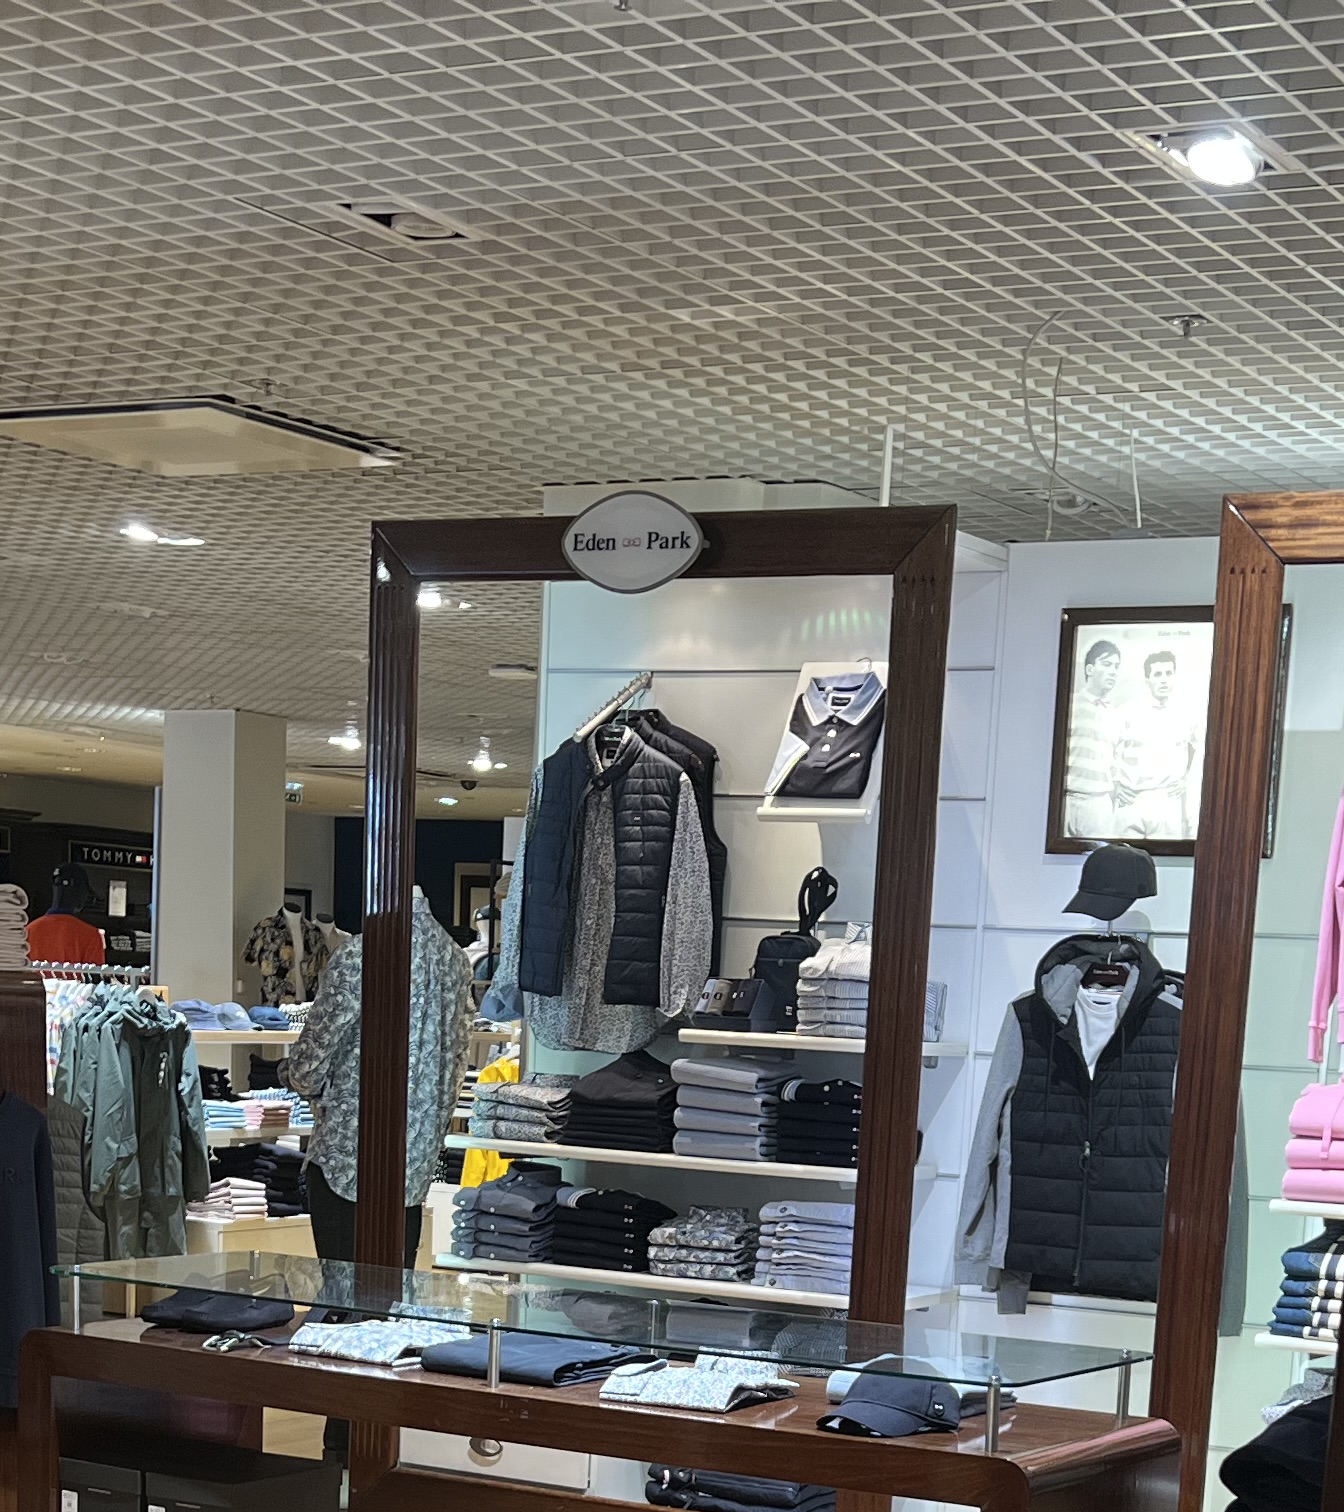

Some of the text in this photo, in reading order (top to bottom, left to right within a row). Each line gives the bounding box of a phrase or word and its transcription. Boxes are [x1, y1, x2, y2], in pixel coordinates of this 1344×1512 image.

[572, 530, 692, 551] Eden Park
[82, 847, 133, 864] TOMMY
